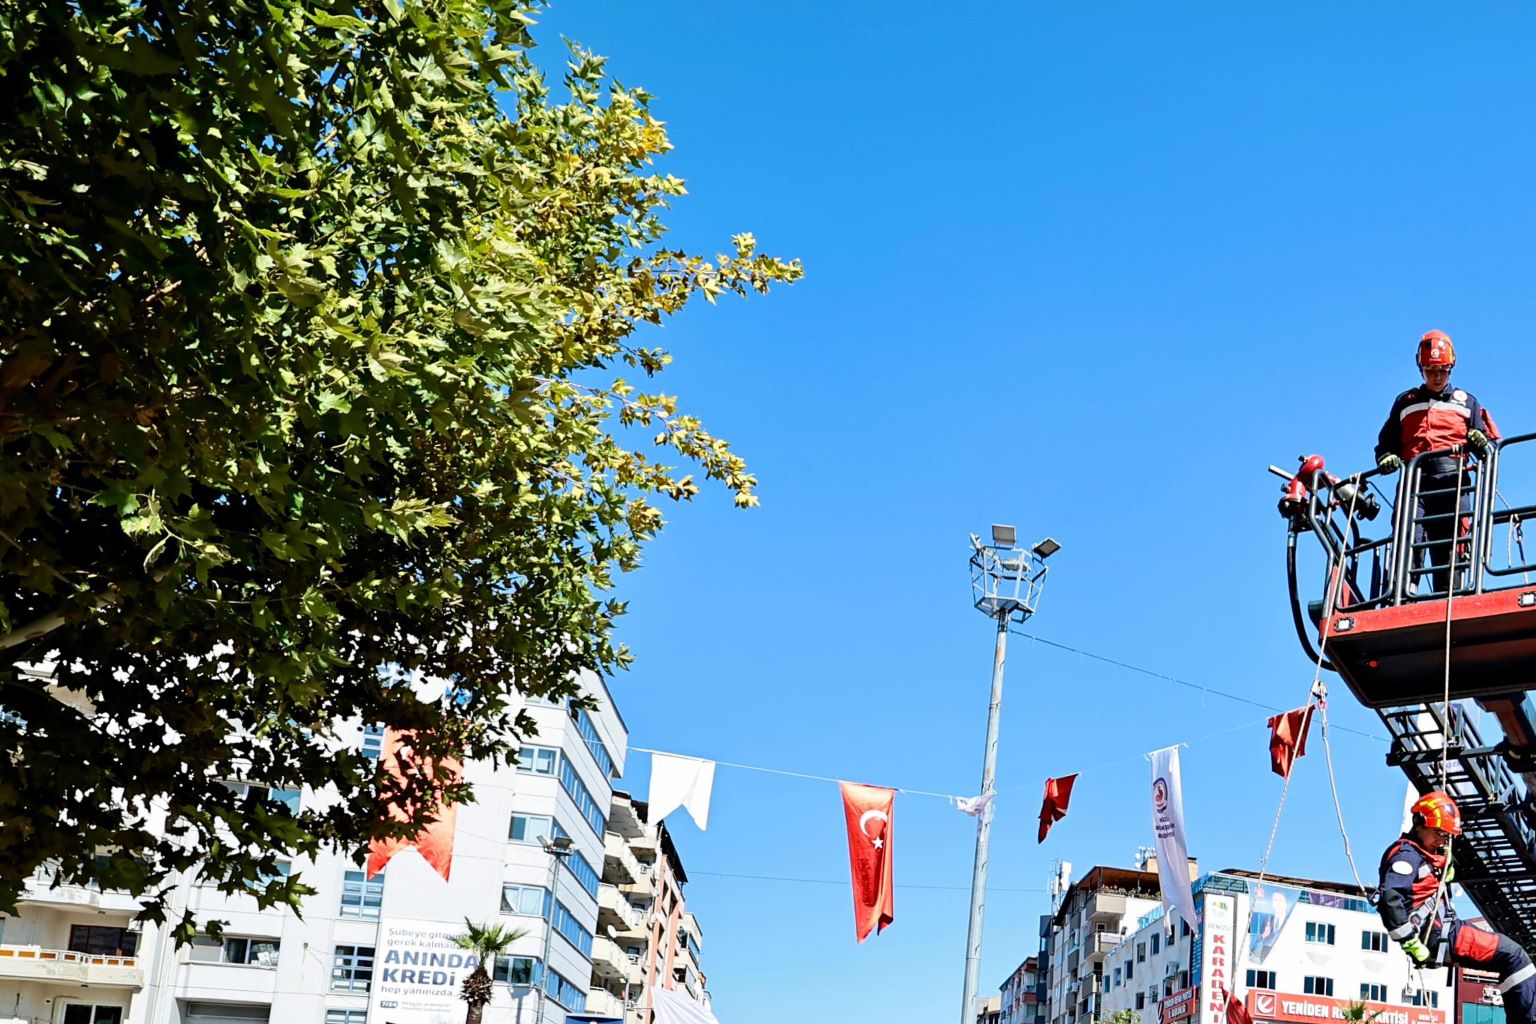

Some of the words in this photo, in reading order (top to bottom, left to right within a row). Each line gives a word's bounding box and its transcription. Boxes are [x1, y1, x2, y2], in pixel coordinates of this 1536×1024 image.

[419, 940, 464, 950] kalmada
[384, 949, 480, 969] ANINDA
[382, 968, 456, 986] KREDİ
[381, 985, 401, 994] hep
[1282, 1000, 1329, 1019] YENİDEN
